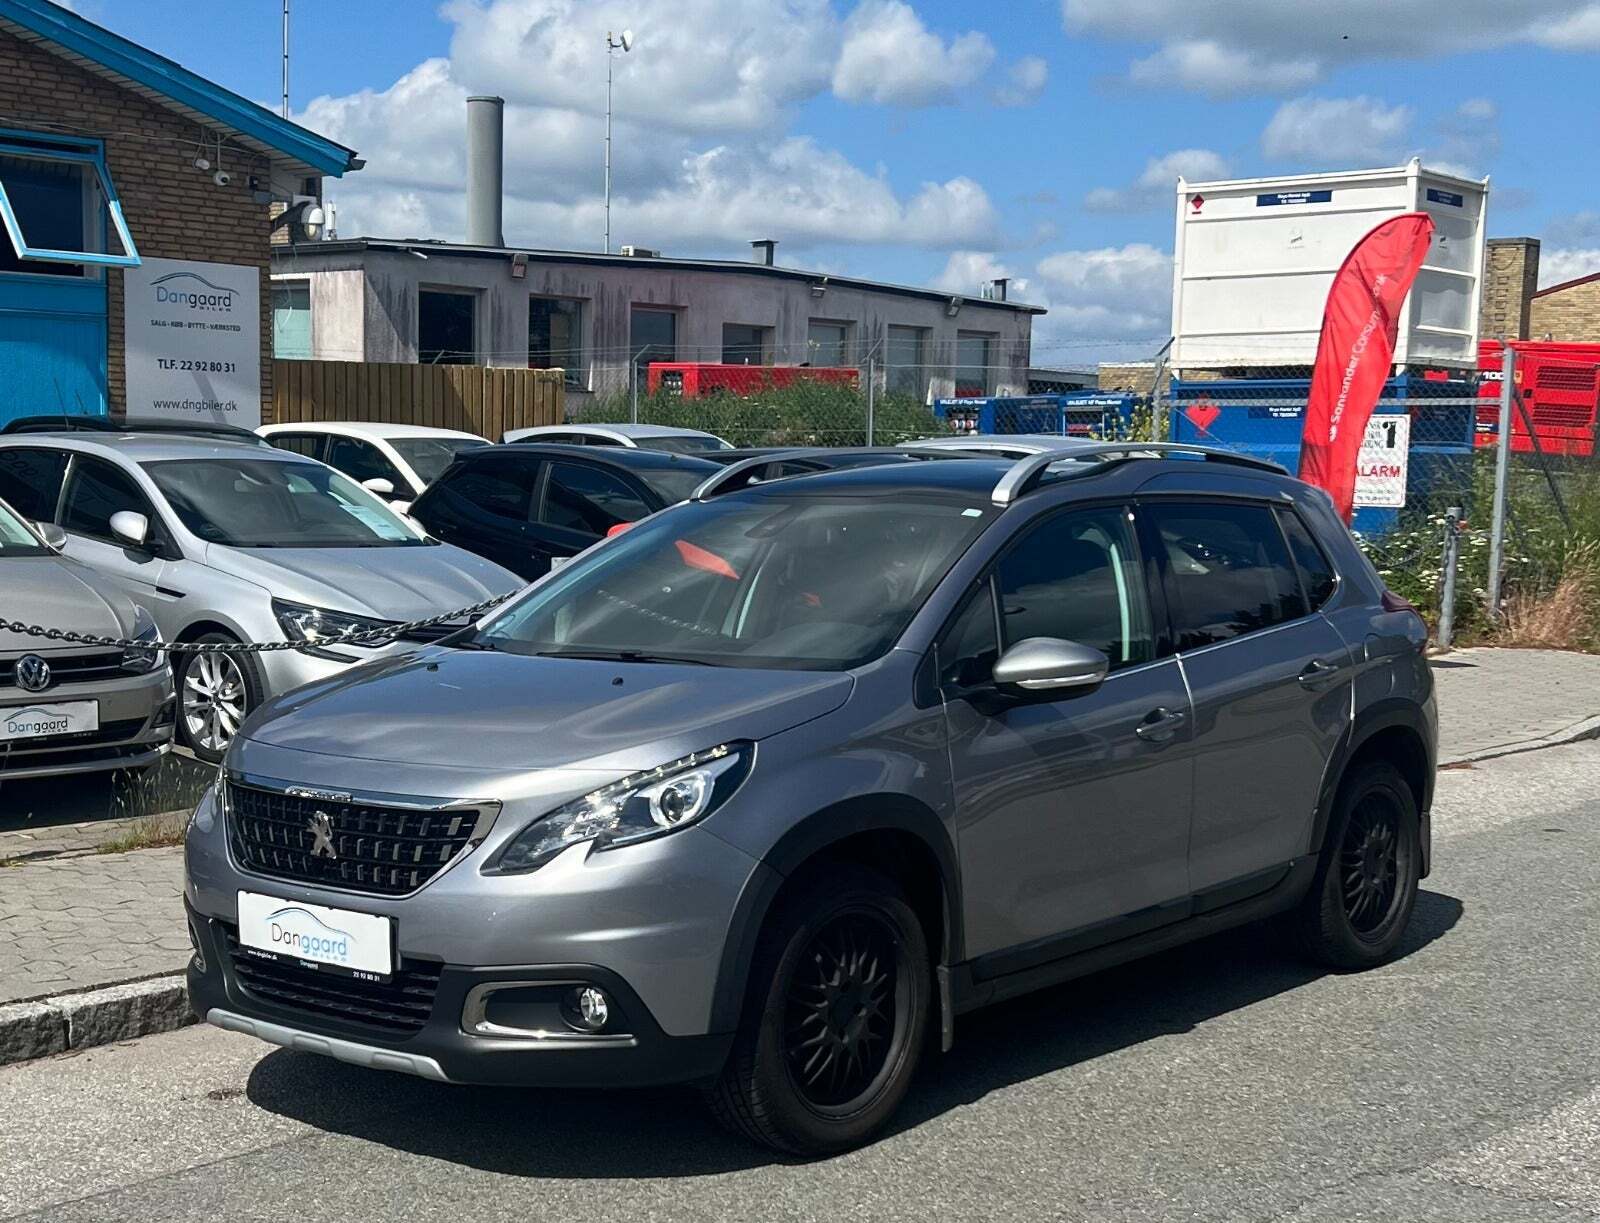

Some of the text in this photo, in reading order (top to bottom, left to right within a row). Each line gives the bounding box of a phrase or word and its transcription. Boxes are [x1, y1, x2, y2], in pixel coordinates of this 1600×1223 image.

[156, 286, 232, 308] Dangaard
[157, 358, 236, 373] TLF. 22 92 80 31
[1331, 355, 1360, 425] Santander
[153, 399, 238, 413] www.dngbiler.dk
[1357, 465, 1400, 477] LARM
[8, 715, 68, 733] Dangaard
[271, 922, 347, 955] Dangaard
